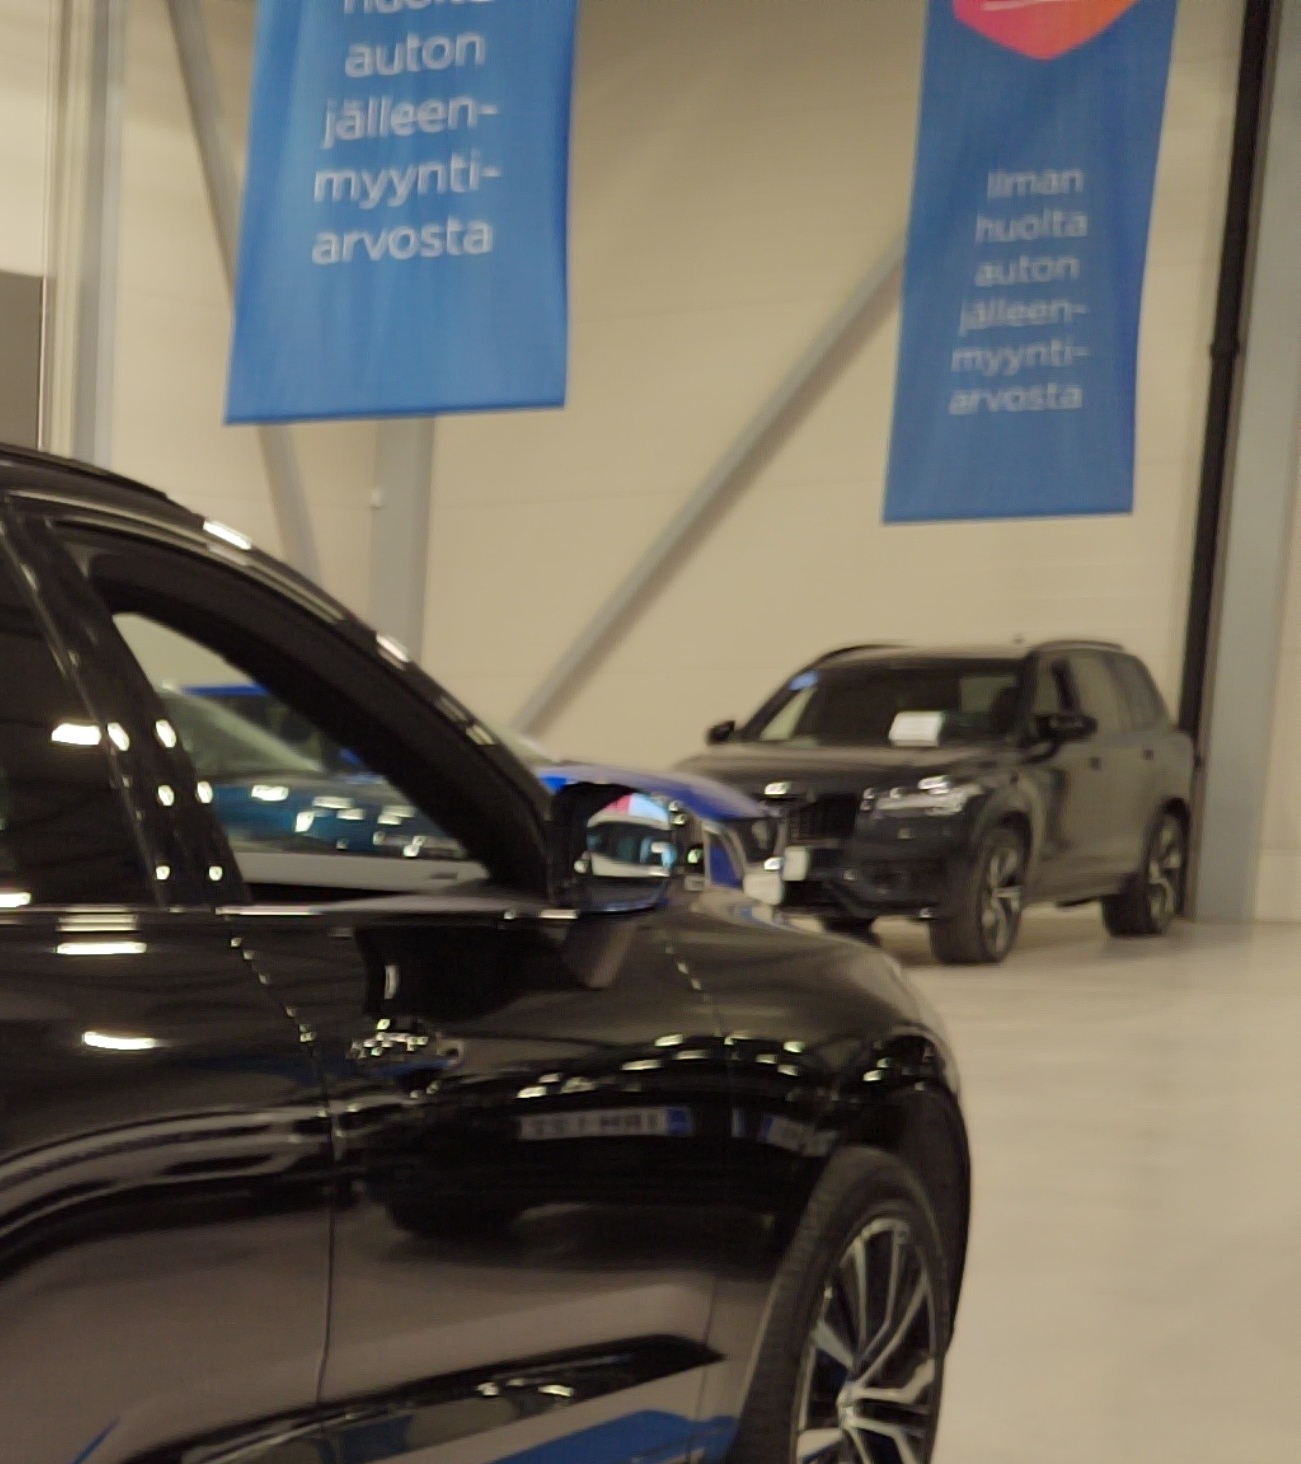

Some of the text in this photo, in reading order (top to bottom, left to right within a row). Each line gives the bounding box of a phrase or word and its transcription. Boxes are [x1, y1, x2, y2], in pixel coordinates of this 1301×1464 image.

[344, 31, 486, 78] auton
[320, 96, 498, 149] jälleen-
[314, 150, 502, 208] myynti-
[312, 216, 494, 264] arvosta
[974, 256, 1080, 287] auton
[951, 338, 1090, 376] myynti-
[948, 383, 1083, 415] arvosta
